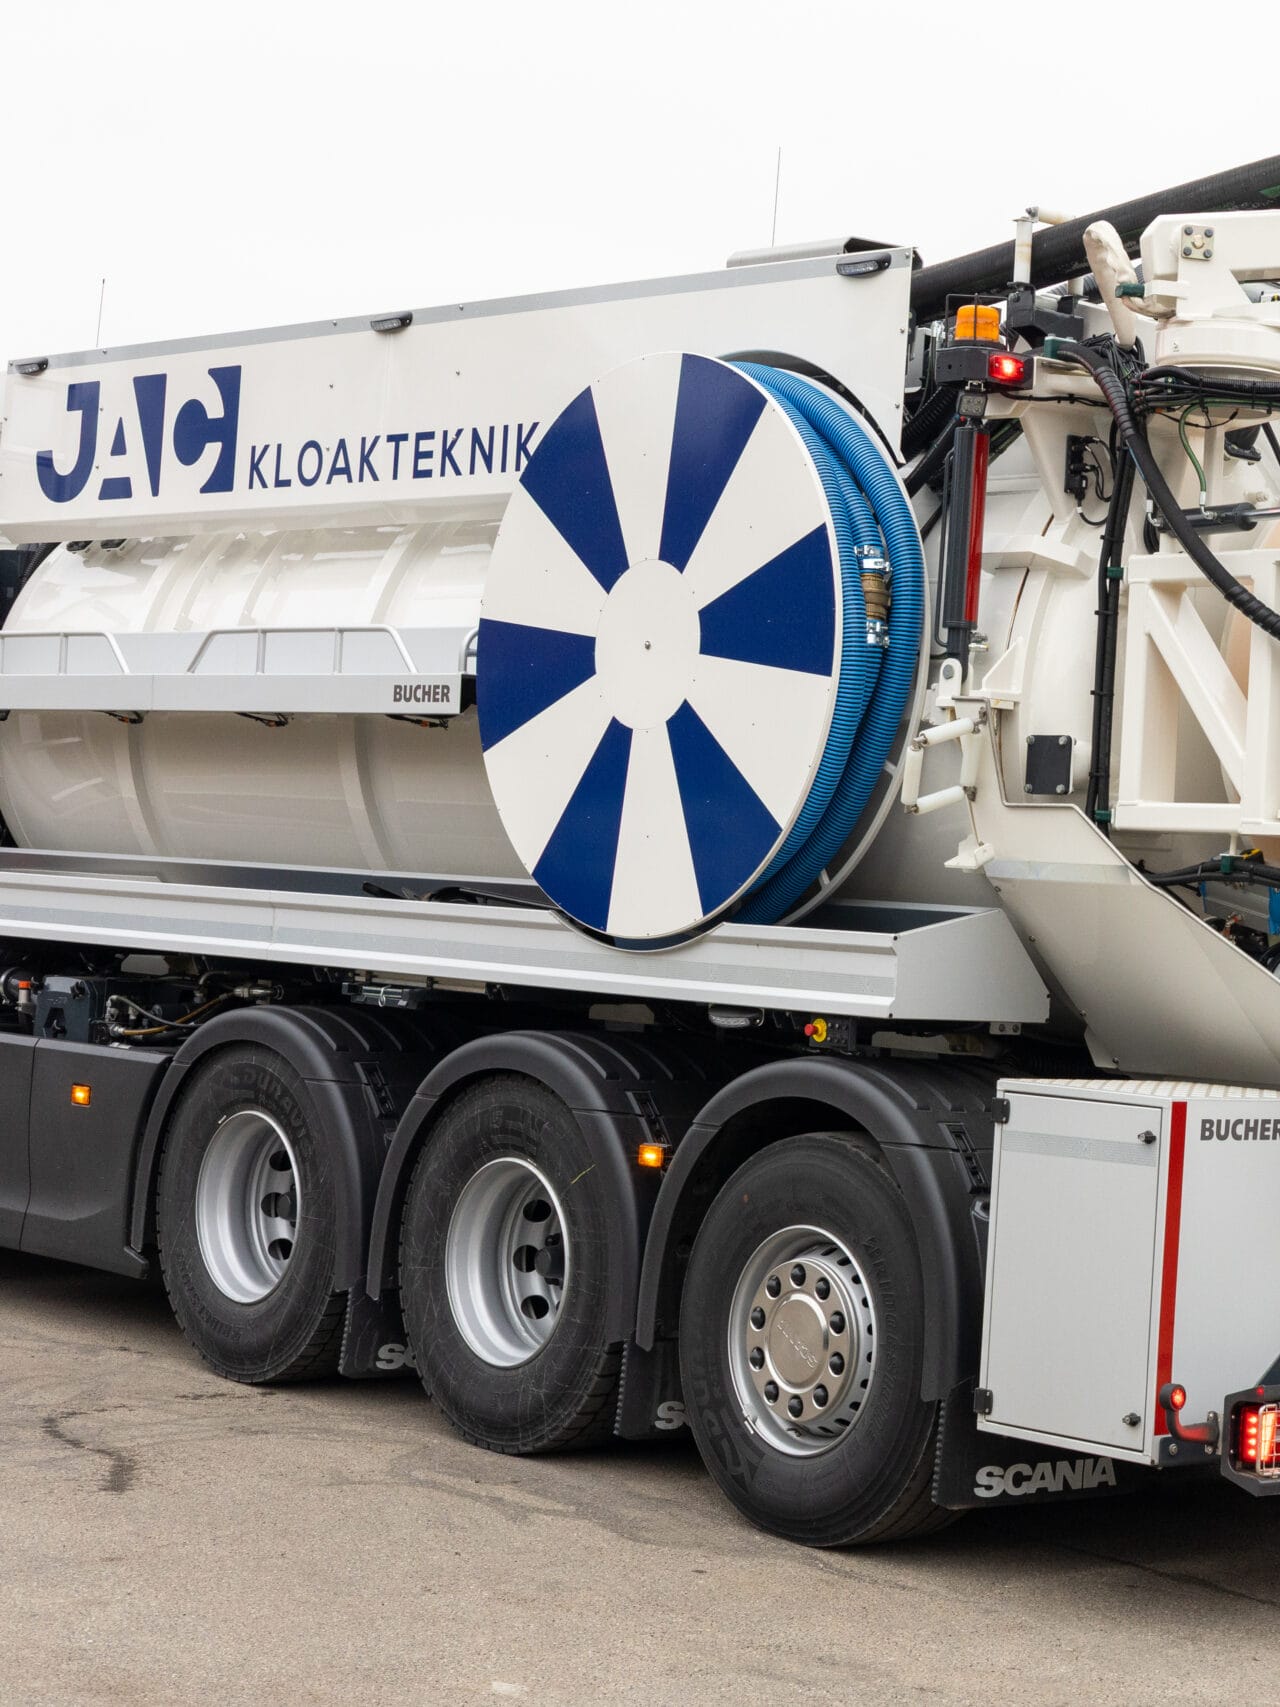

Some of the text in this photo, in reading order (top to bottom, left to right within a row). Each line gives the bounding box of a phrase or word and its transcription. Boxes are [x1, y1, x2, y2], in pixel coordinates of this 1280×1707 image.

[36, 365, 541, 503] JAC KLOAKTEKNIK
[393, 684, 450, 703] BUCHER
[973, 1457, 1117, 1498] SCANIA
